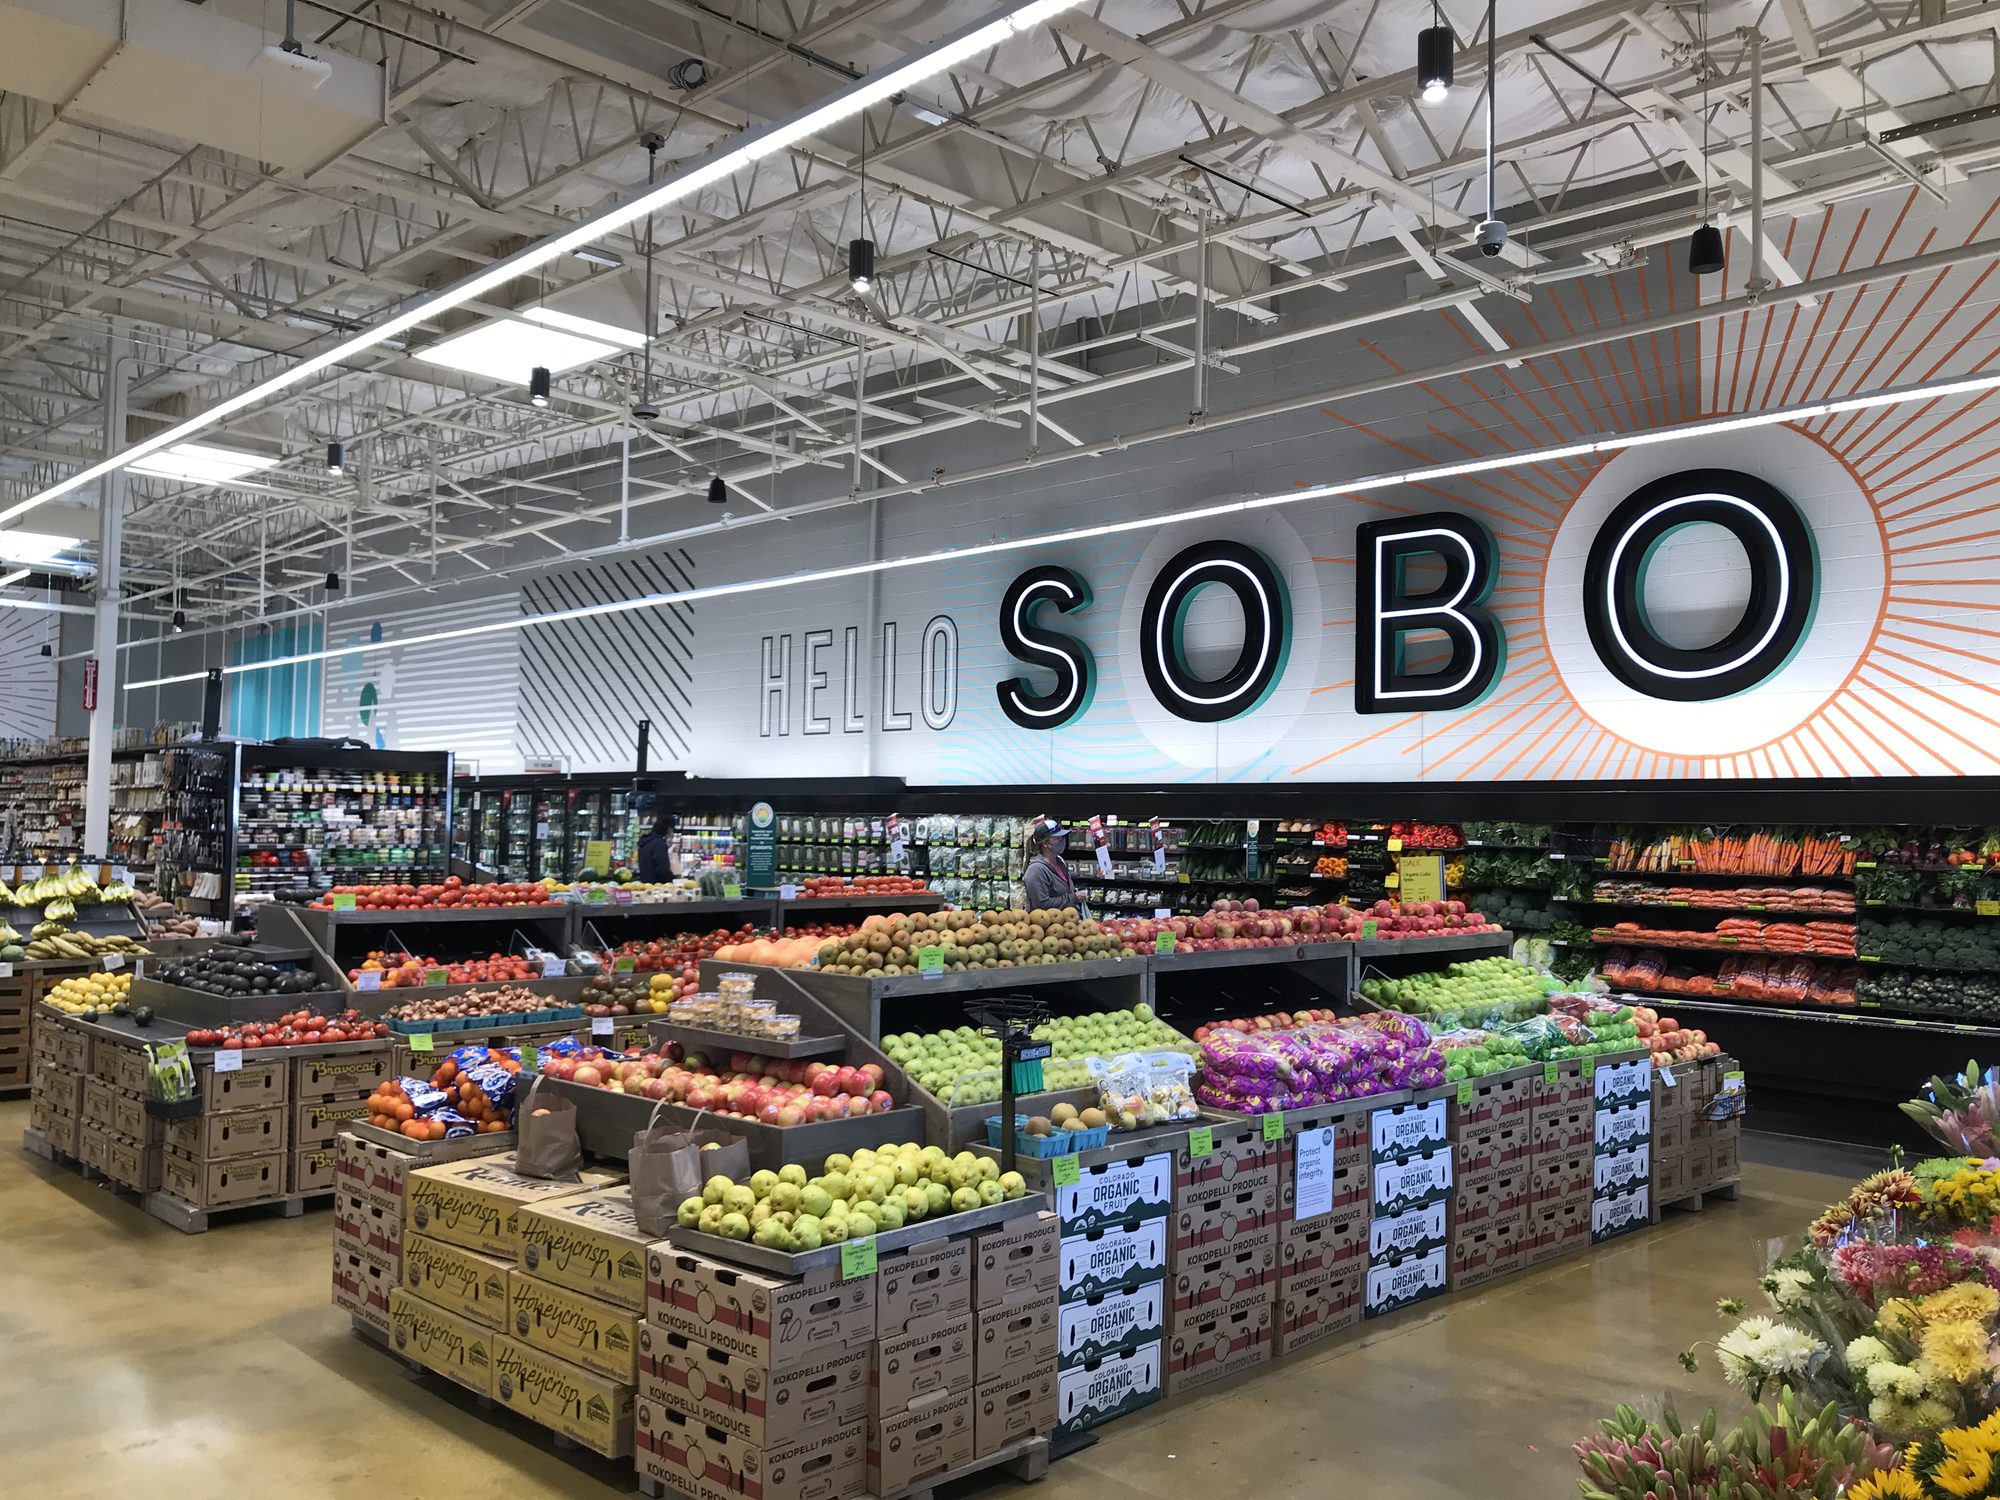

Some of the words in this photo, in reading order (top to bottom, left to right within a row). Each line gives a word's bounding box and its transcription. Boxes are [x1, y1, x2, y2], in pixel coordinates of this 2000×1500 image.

[760, 614, 958, 737] HELLO
[997, 468, 1821, 730] SOBO
[211, 672, 216, 680] 2
[1612, 1074, 1636, 1088] ORGANIC
[306, 1107, 370, 1122] Bravoca
[1398, 1114, 1424, 1124] COLORADO
[1538, 1108, 1565, 1120] KOKOPELLI
[1566, 1104, 1588, 1116] PRODUCE
[1395, 1120, 1426, 1138] ORGANIC
[1466, 1124, 1497, 1138] KOKOPELLI
[1498, 1116, 1524, 1130] PRODUCE
[1612, 1118, 1636, 1132] ORGANIC
[1402, 1134, 1420, 1145] FRUIT
[1300, 1146, 1321, 1158] Protect
[1334, 1154, 1360, 1168] RODUCE
[1538, 1154, 1565, 1166] KOKOPELLI
[1566, 1148, 1588, 1160] PRODUCE
[1298, 1158, 1321, 1170] organic
[1298, 1168, 1324, 1180] integrity.
[1404, 1164, 1430, 1175] COLORADO
[1610, 1162, 1634, 1176] ORGANIC
[1098, 1172, 1136, 1184] COLORADO
[1400, 1170, 1433, 1190] ORGANIC
[1465, 1173, 1496, 1188] KOKOPELLI
[1498, 1164, 1524, 1180] PRODUCE
[1616, 1174, 1629, 1182] FRUIT
[342, 1182, 370, 1200] KOKOPELLI
[368, 1191, 396, 1212] PRODUCE
[1093, 1180, 1140, 1202] ORGANIC
[1186, 1184, 1230, 1205] KOKOPELLI
[1232, 1175, 1268, 1193] PRODUCE
[1408, 1184, 1426, 1196] FRUIT
[411, 1180, 500, 1235] Honeycrisp
[1103, 1198, 1129, 1212] FRUIT
[1537, 1202, 1564, 1216] KOKOPELLI
[1566, 1194, 1588, 1208] PRODUCE
[1609, 1204, 1633, 1219] ORGANIC
[1290, 1218, 1328, 1236] KOKOPELLI
[1330, 1210, 1361, 1226] PRODUCE
[1392, 1220, 1426, 1241] ORGANIC
[1396, 1214, 1424, 1226] COLORADO
[1462, 1222, 1492, 1238] KOKOPELLI
[1494, 1212, 1520, 1228] PRODUCE
[521, 1218, 610, 1279] Honeycrisp
[981, 1236, 1022, 1252] KOKOPELLI
[1023, 1226, 1056, 1242] PRODUCE
[1096, 1236, 1132, 1251] COLORADO
[1187, 1246, 1230, 1266] KOKOPELLI
[1232, 1234, 1269, 1252] PRODUCE
[1400, 1234, 1418, 1247] FRUIT
[338, 1238, 366, 1258] KOKOPELLI
[366, 1250, 392, 1270] PRODUCE
[884, 1257, 928, 1276] KOKOPELLI
[930, 1246, 966, 1264] PRODUCE
[1090, 1244, 1136, 1270] ORGANIC
[406, 1239, 478, 1296] Honeycrisp
[1100, 1262, 1126, 1278] FRUIT
[1290, 1274, 1328, 1294] KOKOPELLI
[1330, 1262, 1362, 1281] PRODUCE
[1396, 1263, 1422, 1276] COLORADO
[1460, 1270, 1491, 1286] KOKOPELLI
[1492, 1260, 1519, 1276] PRODUCE
[1392, 1268, 1426, 1290] ORGANIC
[1398, 1284, 1417, 1296] FRUIT
[776, 1284, 827, 1304] KOKOPELLI
[337, 1295, 365, 1317] KOKOPELLI
[364, 1309, 390, 1331] PRODUCE
[513, 1284, 598, 1348] Honeycrisp
[982, 1307, 1021, 1325] KOKOPELLI
[1022, 1296, 1055, 1312] PRODUCE
[1096, 1299, 1131, 1316] COLORADO
[1184, 1308, 1228, 1328] KOKOPELLI
[1230, 1292, 1266, 1312] PRODUCE
[392, 1300, 463, 1362] Honeycrisp
[1090, 1306, 1135, 1334] ORGANIC
[657, 1310, 708, 1340] KOKOPELLI
[710, 1330, 758, 1358] PRODUCE
[884, 1332, 928, 1355] KOKOPELLI
[931, 1322, 968, 1341] PRODUCE
[1100, 1326, 1124, 1342] FRUIT
[1289, 1330, 1323, 1350] KOKOPELLI
[1324, 1314, 1352, 1332] PRODUCE
[773, 1362, 824, 1386] KOKOPELLI
[826, 1350, 866, 1372] PRODUCE
[1094, 1363, 1128, 1380] COLORADO
[1178, 1368, 1223, 1390] KOKOPELLI
[1224, 1352, 1262, 1374] PRODUCE
[496, 1347, 578, 1416] Honeycrisp
[980, 1379, 1020, 1398] KOKOPELLI
[1021, 1364, 1054, 1382] PRODUCE
[1088, 1370, 1133, 1400] ORGANIC
[1098, 1390, 1122, 1408] FRUIT
[649, 1384, 700, 1416] KOKOPELLI
[702, 1406, 751, 1438] PRODUCE
[886, 1414, 931, 1434] KOKOPELLI
[932, 1396, 969, 1416] PRODUCE
[768, 1442, 819, 1464] KOKOPELLI
[821, 1425, 862, 1446] PRODUCE
[646, 1460, 698, 1496] KOKOPELLI
